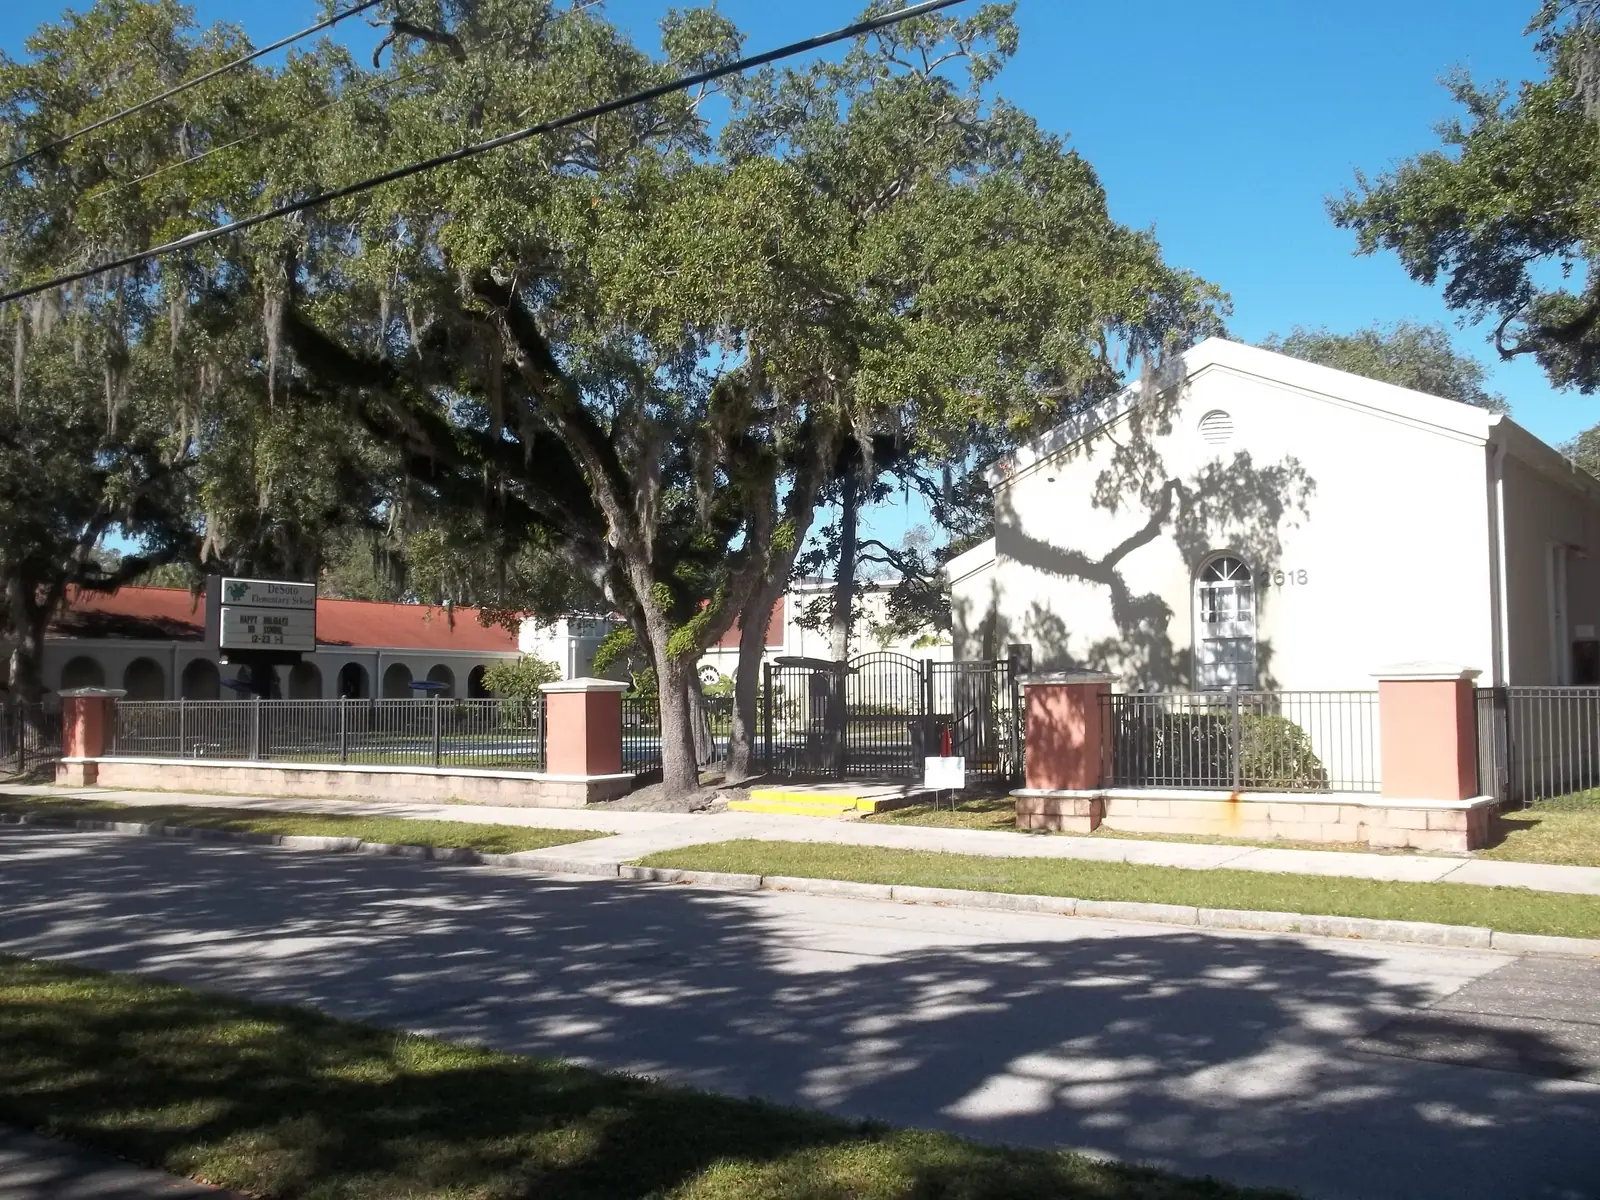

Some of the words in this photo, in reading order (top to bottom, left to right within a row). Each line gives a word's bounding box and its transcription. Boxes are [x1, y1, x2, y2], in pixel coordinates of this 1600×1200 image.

[1260, 569, 1308, 587] 2618
[268, 584, 299, 595] DeSoto
[252, 594, 290, 605] Elementary
[292, 596, 313, 605] School
